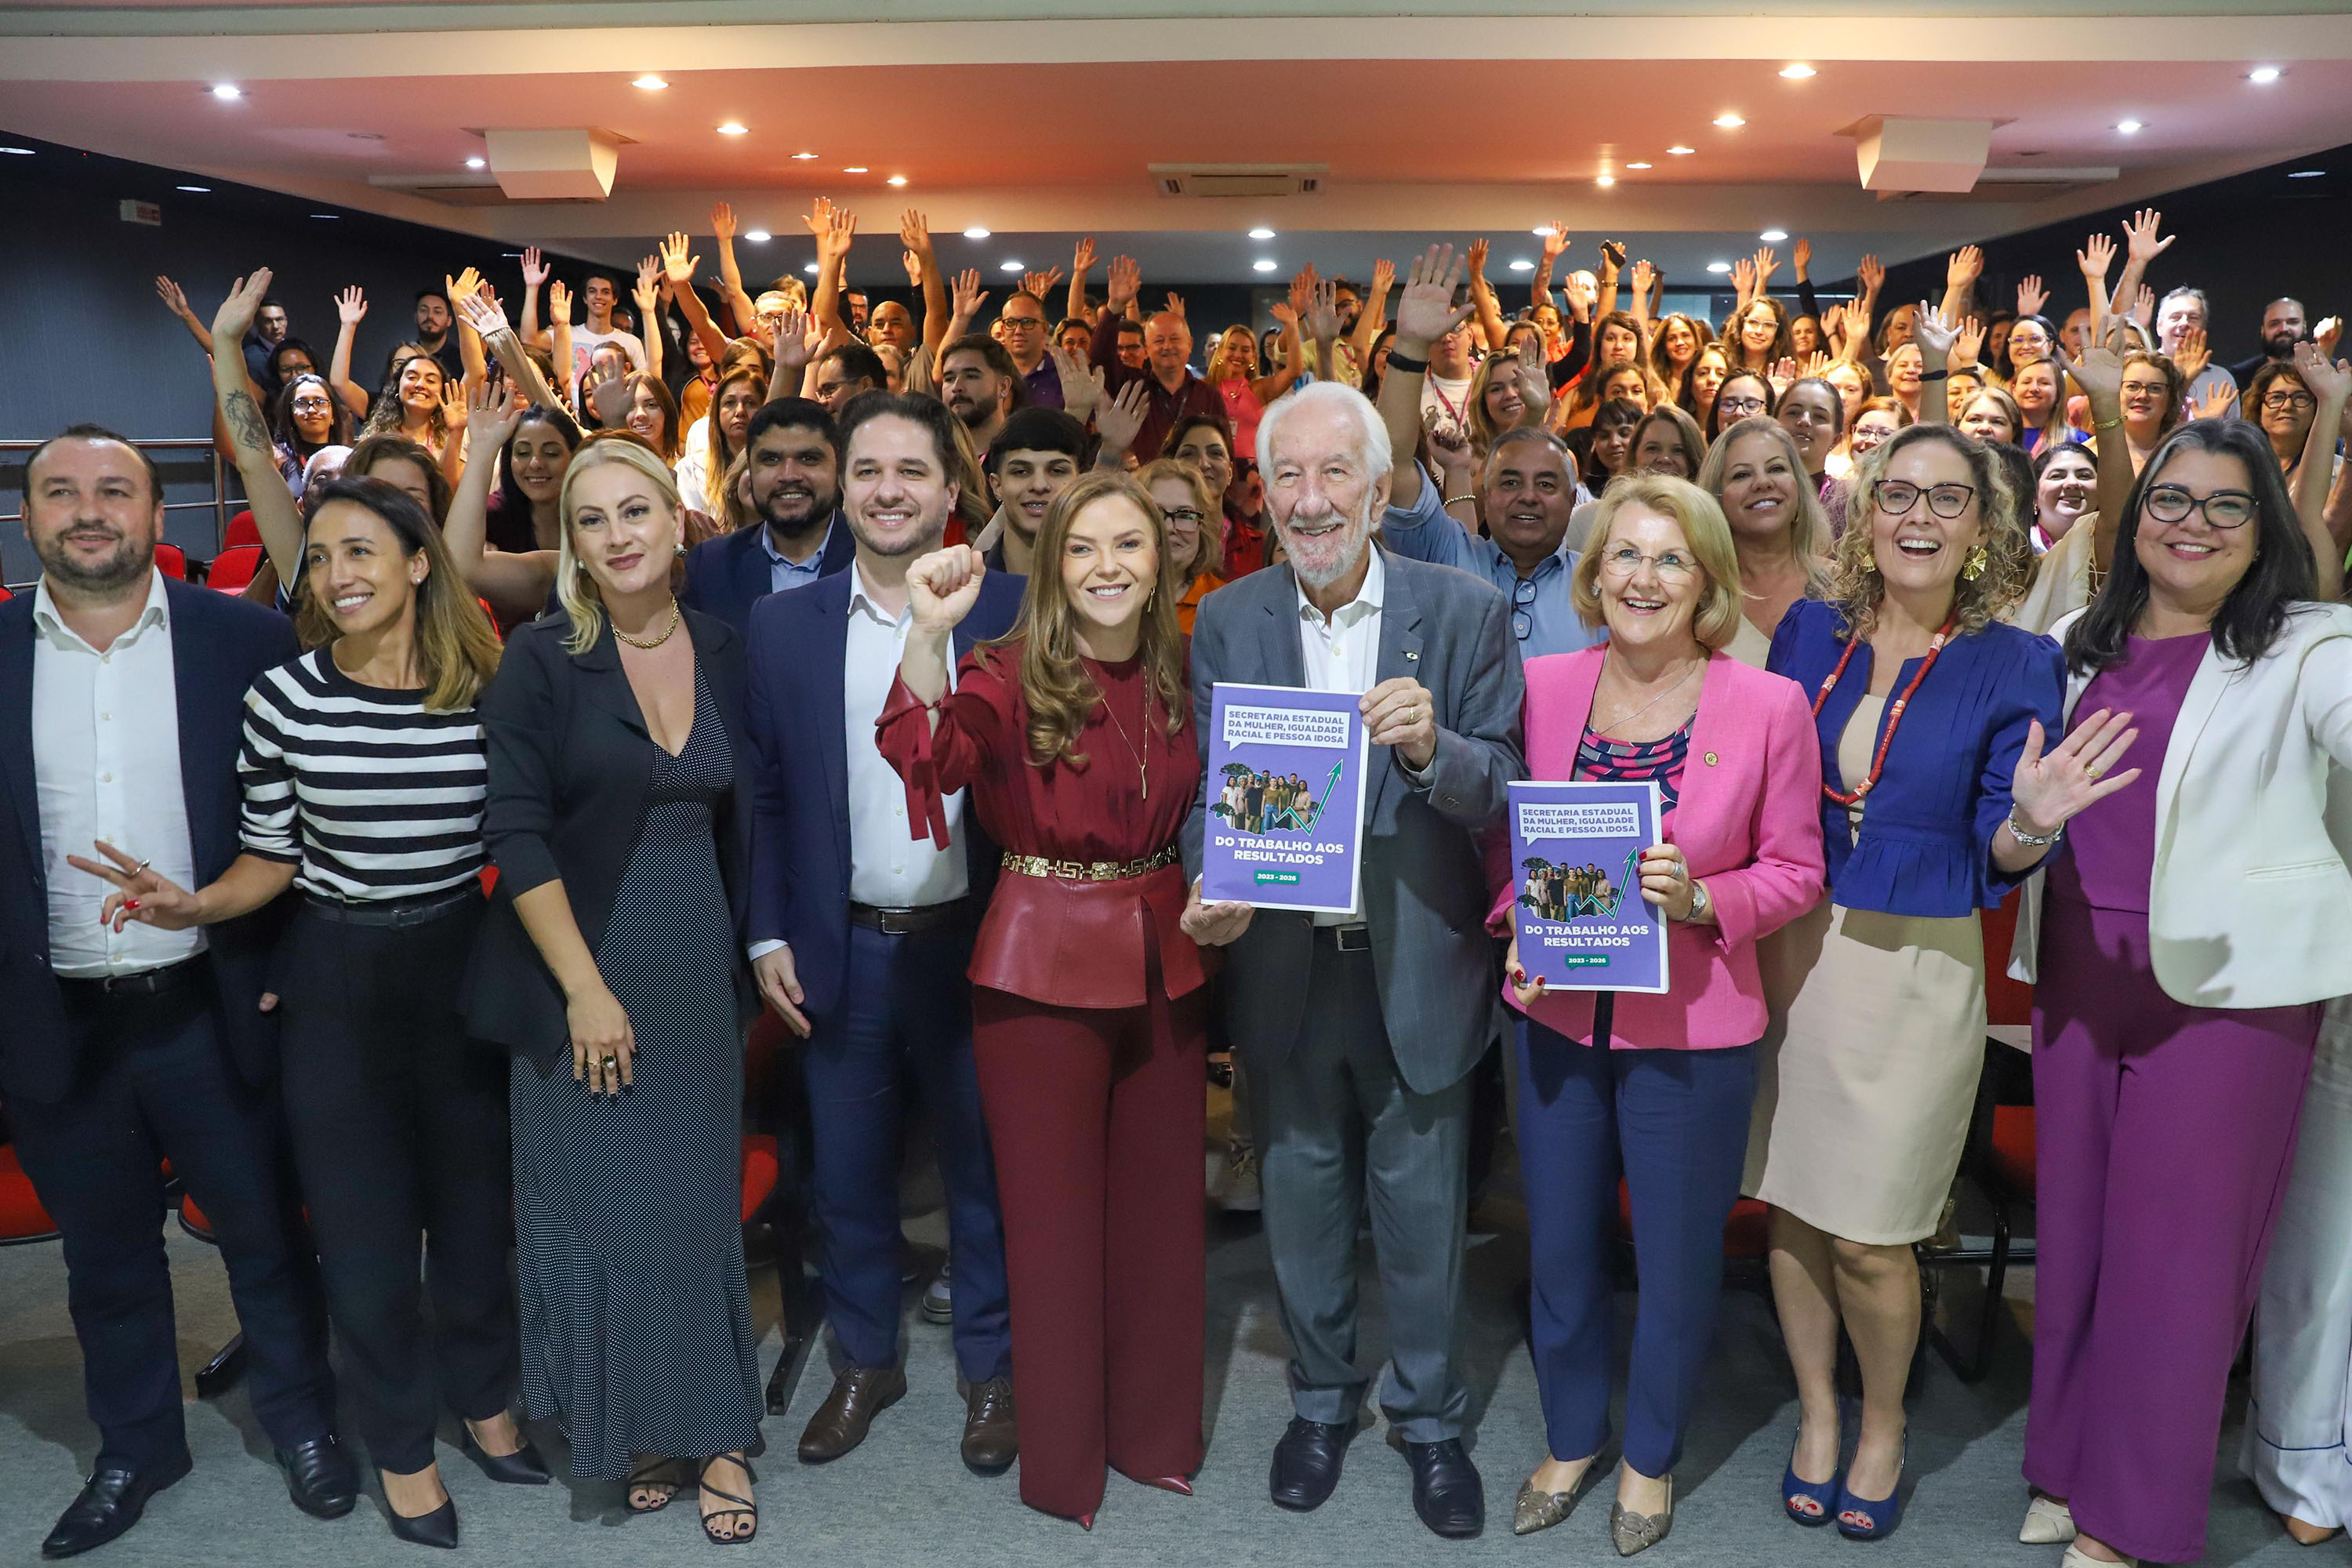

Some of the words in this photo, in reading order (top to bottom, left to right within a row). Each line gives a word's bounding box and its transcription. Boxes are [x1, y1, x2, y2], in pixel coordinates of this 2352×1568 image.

[1229, 710, 1290, 722] SECRETARIA
[1292, 715, 1345, 724] ESTADUAL
[1244, 721, 1286, 731] MULHER,
[1288, 724, 1344, 734] IGUALDADE
[1228, 729, 1263, 739] RACIAL
[1273, 732, 1312, 741] PESSOA
[1314, 735, 1344, 743] IDOSA
[1215, 836, 1235, 847] DO
[1238, 837, 1312, 851] TRABALHO
[1315, 842, 1345, 854] AOS
[1234, 850, 1323, 865] RESULTADOS
[1525, 925, 1543, 935] DO
[1546, 925, 1617, 935] TRABALHO
[1621, 925, 1649, 935] AOS
[1544, 937, 1630, 947] RESULTADOS
